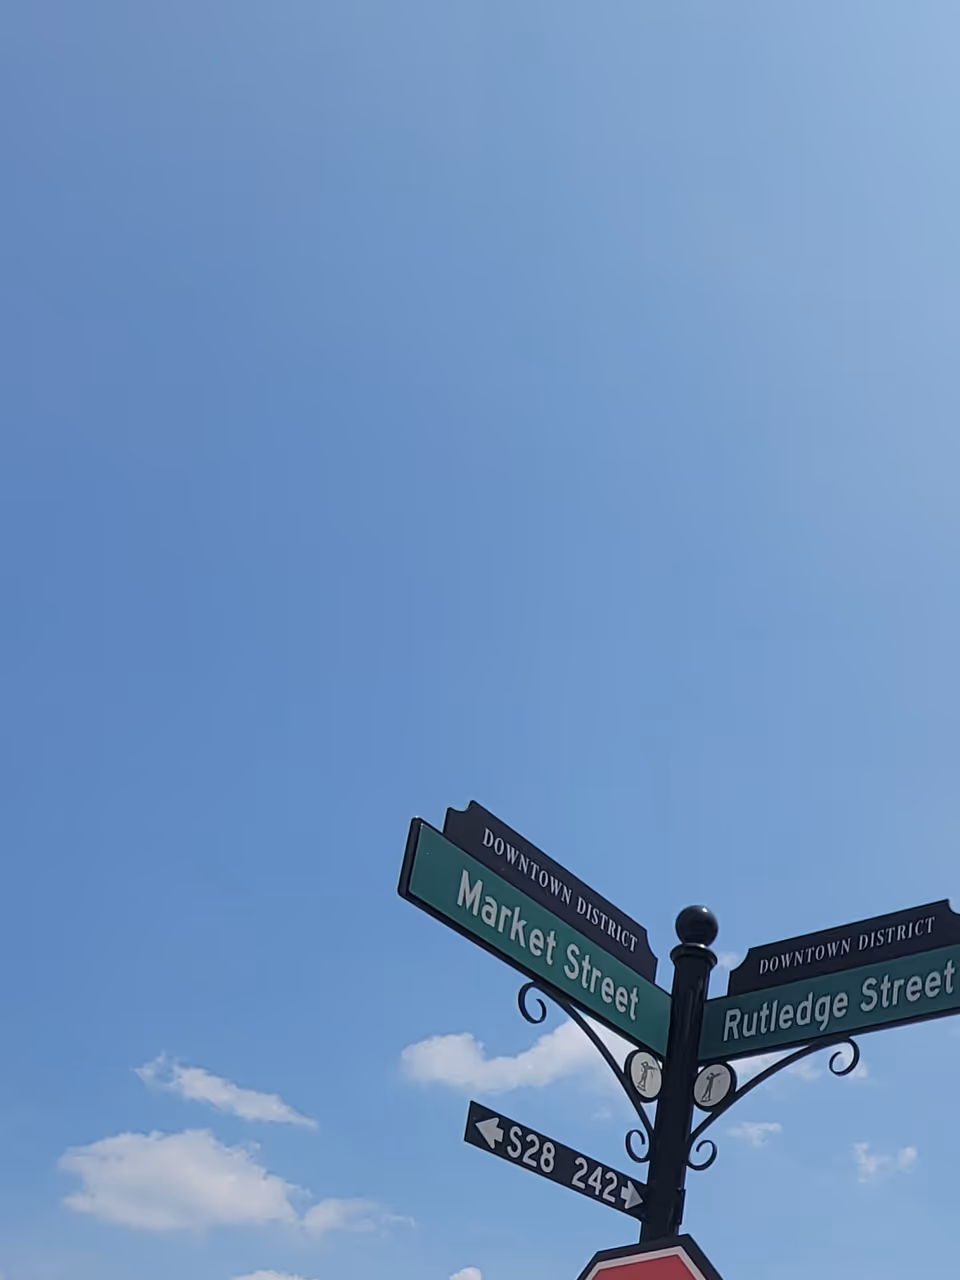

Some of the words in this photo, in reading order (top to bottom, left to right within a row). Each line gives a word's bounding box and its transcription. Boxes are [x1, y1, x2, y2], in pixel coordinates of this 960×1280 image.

[482, 826, 572, 906] DOWNTOWN
[576, 896, 639, 953] DISTRICT
[456, 869, 557, 966] Market
[563, 943, 640, 1021] Street
[759, 936, 852, 975] DOWNTOWN
[858, 916, 936, 951] DISTRICT
[722, 990, 849, 1042] Rutledge
[860, 959, 956, 1012] Street
[506, 1125, 556, 1173] S28
[571, 1157, 618, 1203] 242
